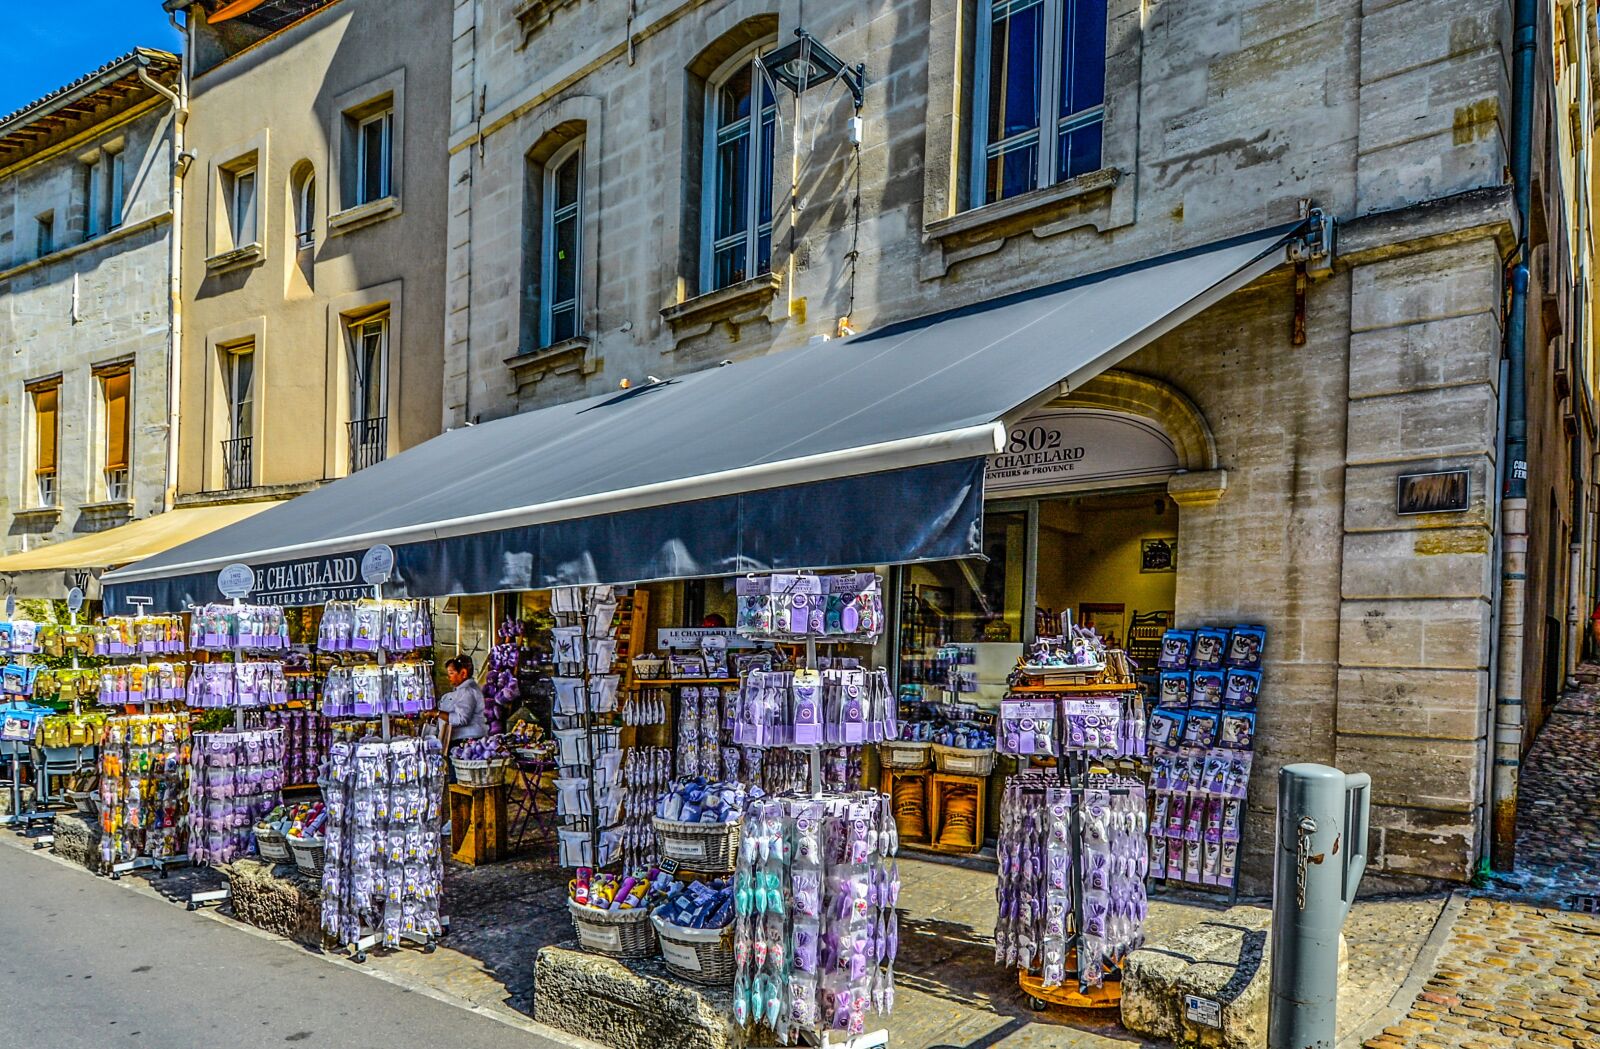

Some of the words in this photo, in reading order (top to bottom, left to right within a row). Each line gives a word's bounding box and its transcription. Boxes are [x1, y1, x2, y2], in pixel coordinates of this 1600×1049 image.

[1003, 427, 1061, 454] 802
[994, 447, 1085, 468] CHATELARD
[1032, 463, 1075, 475] PROVENCE
[266, 557, 357, 591] CHATELARD
[257, 592, 304, 605] SENTEURS
[308, 592, 316, 602] de
[681, 630, 726, 638] CHATELARD
